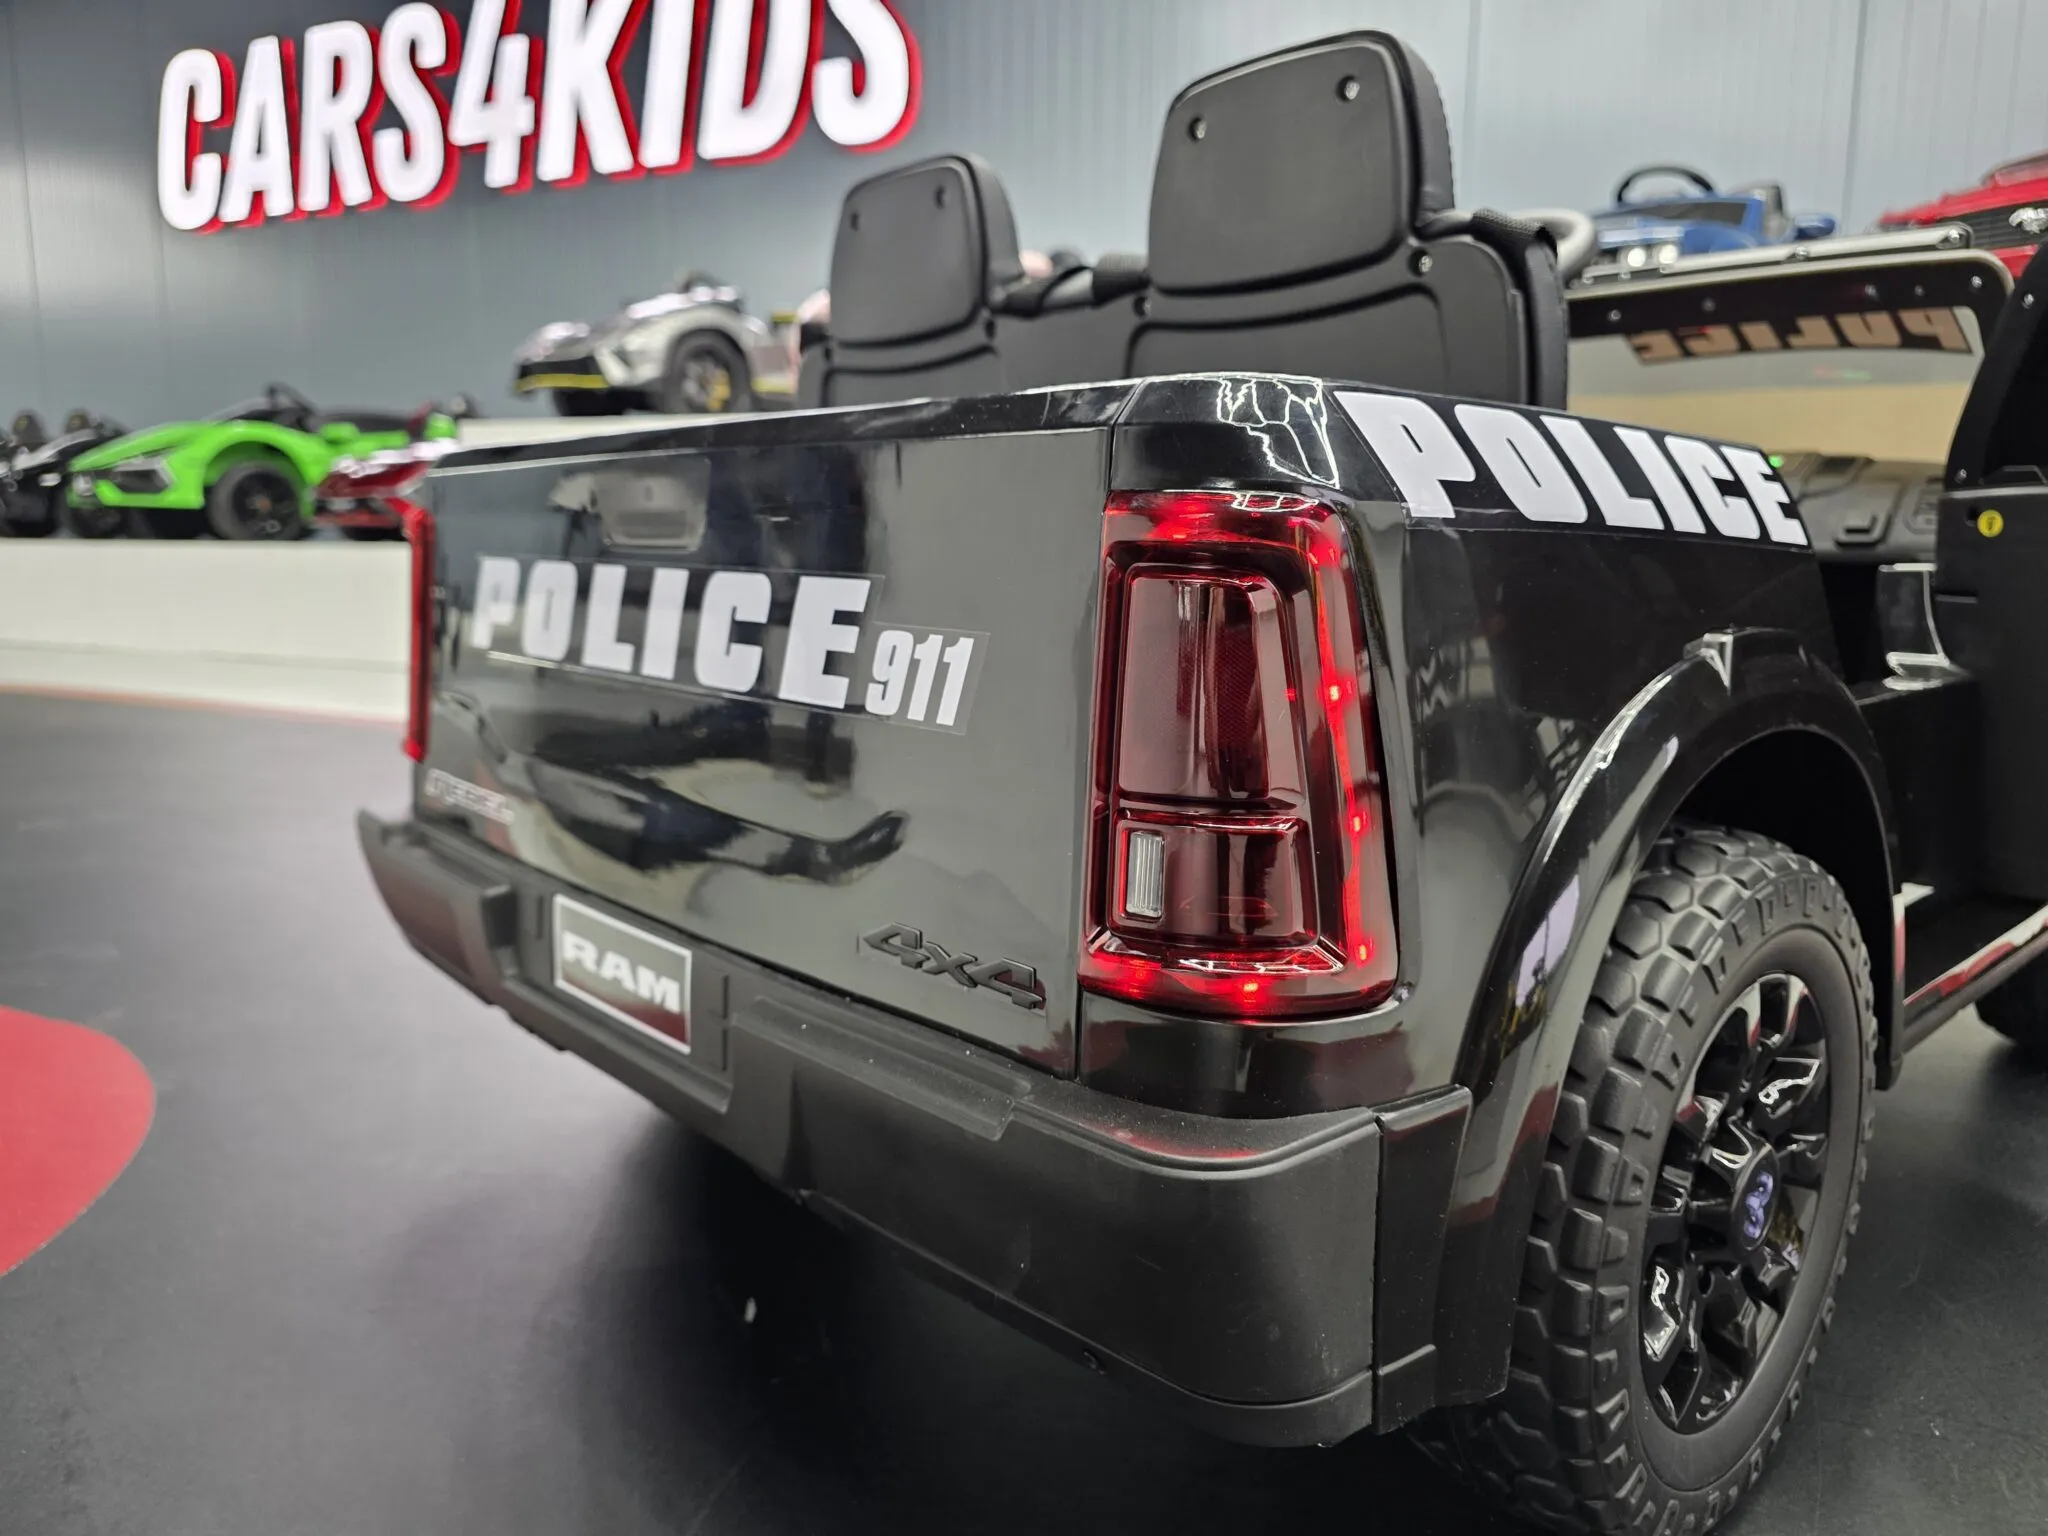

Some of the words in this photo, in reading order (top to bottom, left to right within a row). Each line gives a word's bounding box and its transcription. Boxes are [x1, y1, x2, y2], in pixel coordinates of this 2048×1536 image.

[157, 0, 914, 231] CARS4KIDS
[1332, 390, 1808, 546] POLICE
[468, 556, 872, 710] POLICE
[864, 629, 974, 727] 911
[562, 930, 681, 1015] RAM
